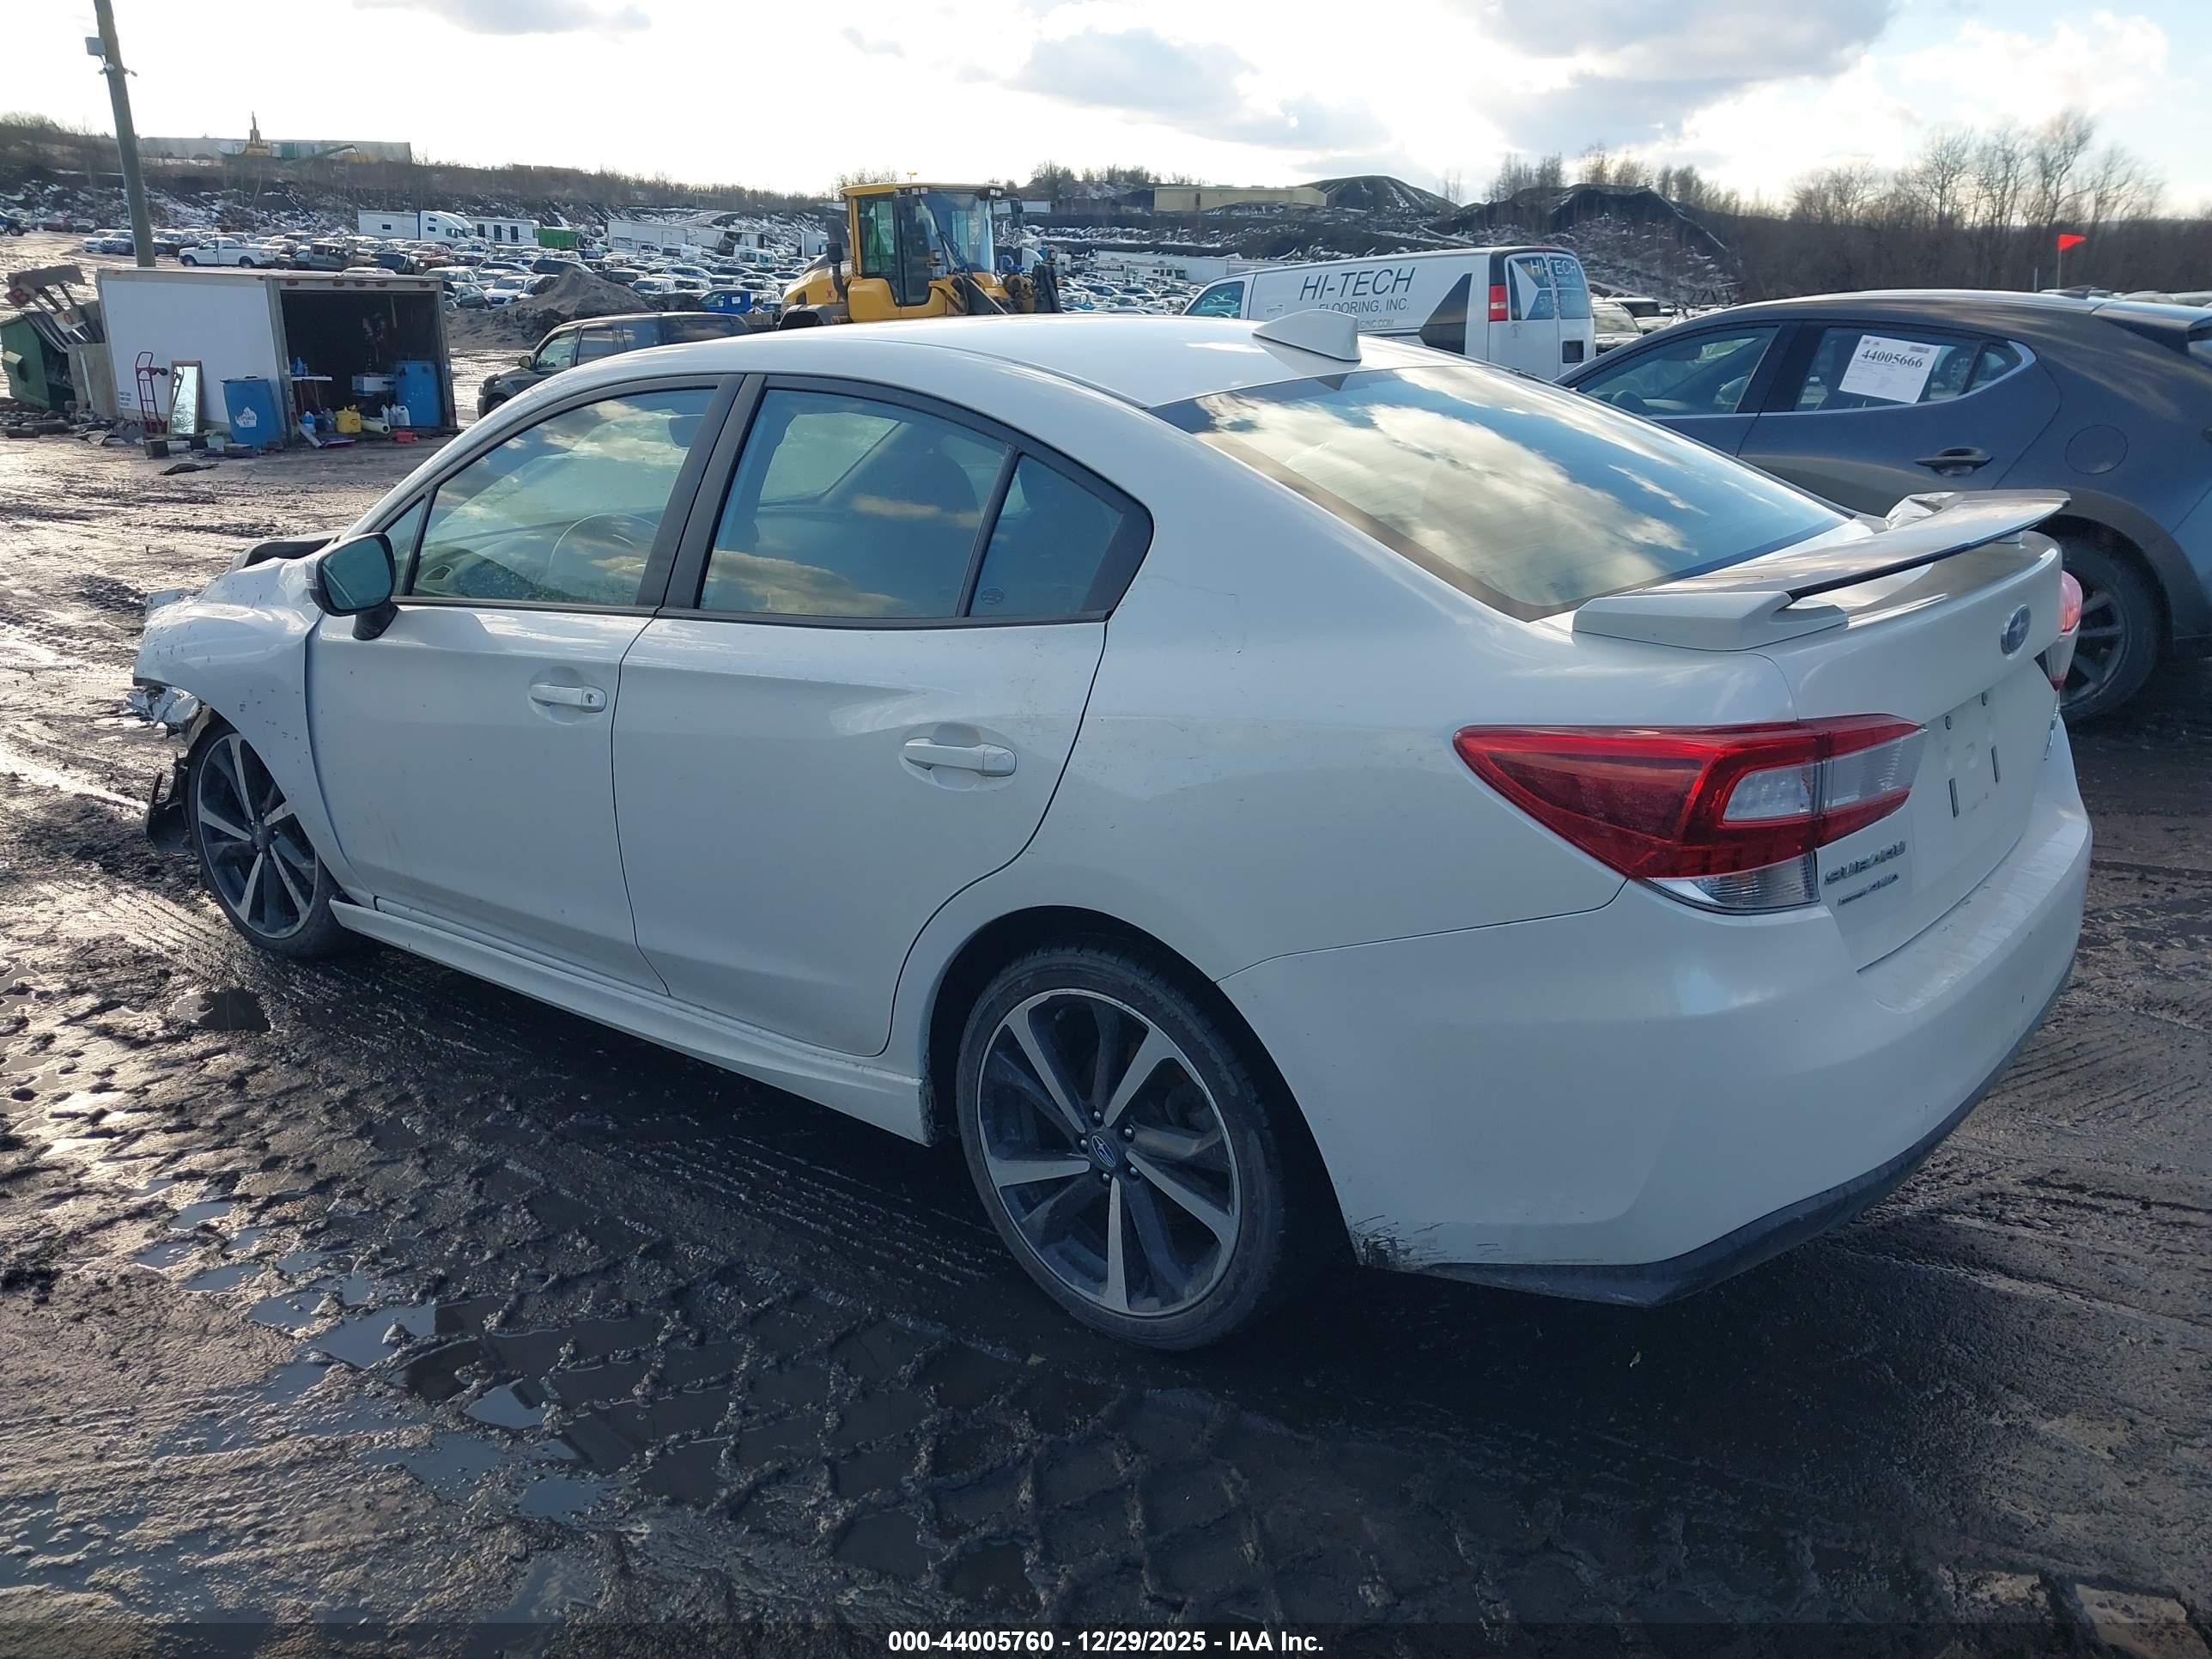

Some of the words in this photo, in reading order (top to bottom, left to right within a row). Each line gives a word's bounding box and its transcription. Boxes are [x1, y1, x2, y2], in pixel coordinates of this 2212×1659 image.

[1299, 266, 1416, 301] HI-TECH
[1385, 297, 1410, 311] INC.
[1861, 349, 1924, 368] 44005666
[1824, 840, 1906, 886] SUBARU
